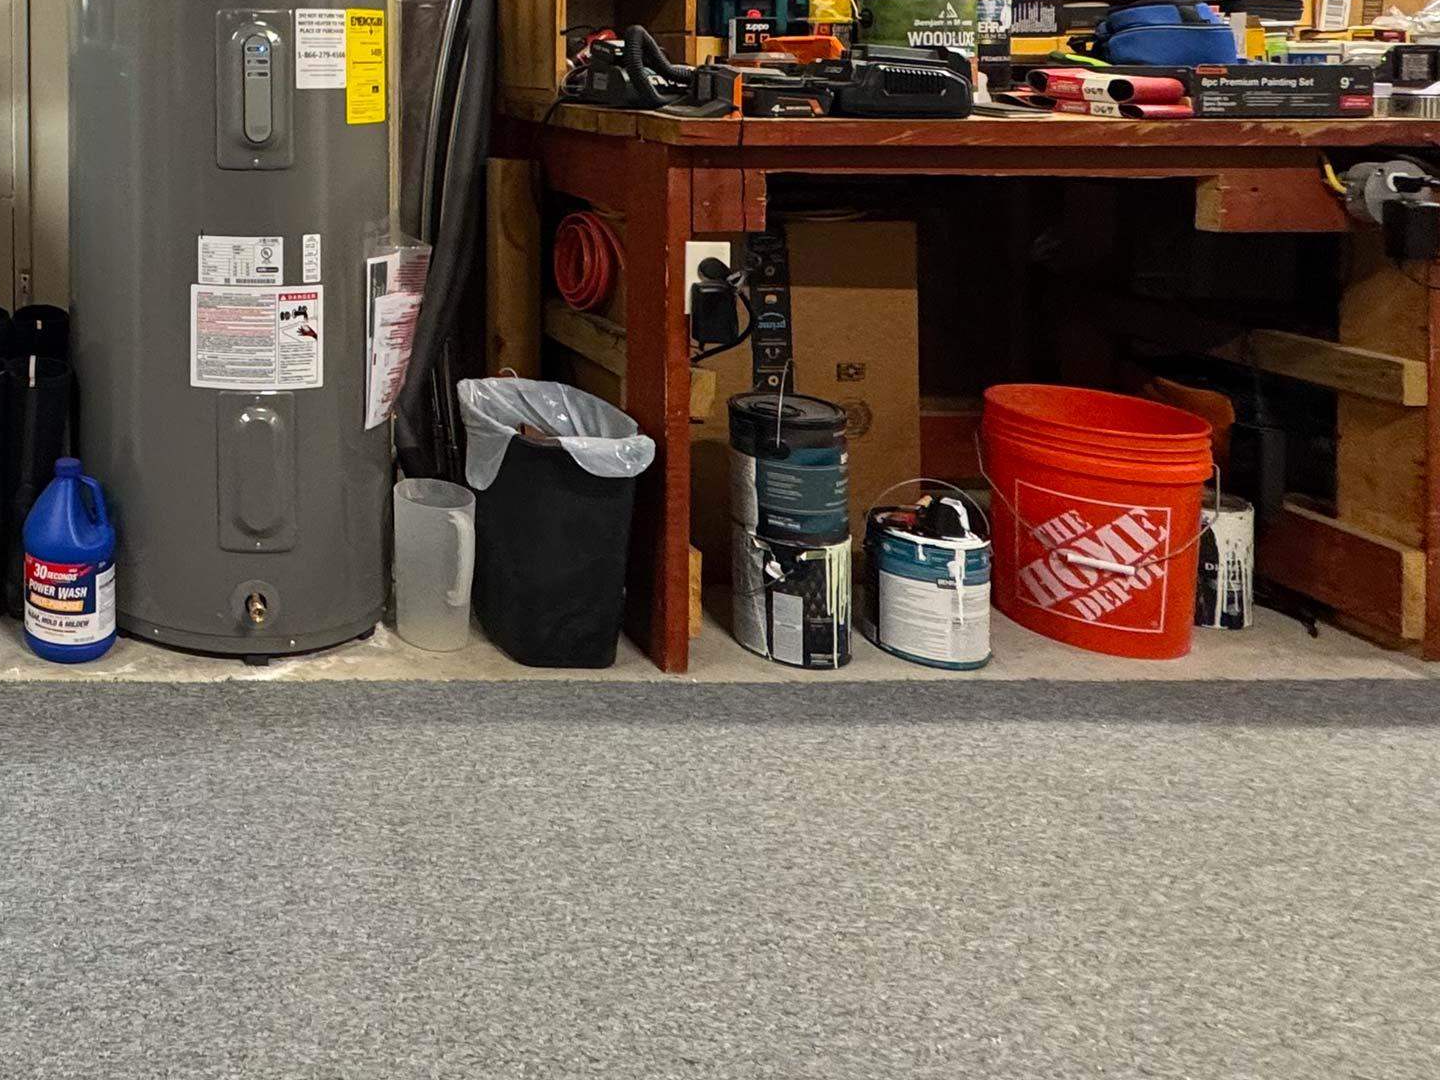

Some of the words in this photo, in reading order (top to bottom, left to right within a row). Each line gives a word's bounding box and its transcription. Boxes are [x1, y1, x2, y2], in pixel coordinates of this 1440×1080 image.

[745, 23, 769, 31] zippo
[907, 30, 975, 47] WOODLUXE
[1201, 77, 1218, 88] 8pc
[1220, 77, 1259, 87] Premium
[1261, 77, 1297, 88] Painting
[1299, 77, 1314, 87] Set
[1033, 509, 1093, 549] THE
[1019, 508, 1167, 608] HOME
[33, 563, 48, 580] 30
[48, 571, 78, 582] SECONDS
[28, 578, 56, 597] POWER
[58, 586, 88, 600] WASH
[1069, 555, 1165, 620] DEPOT
